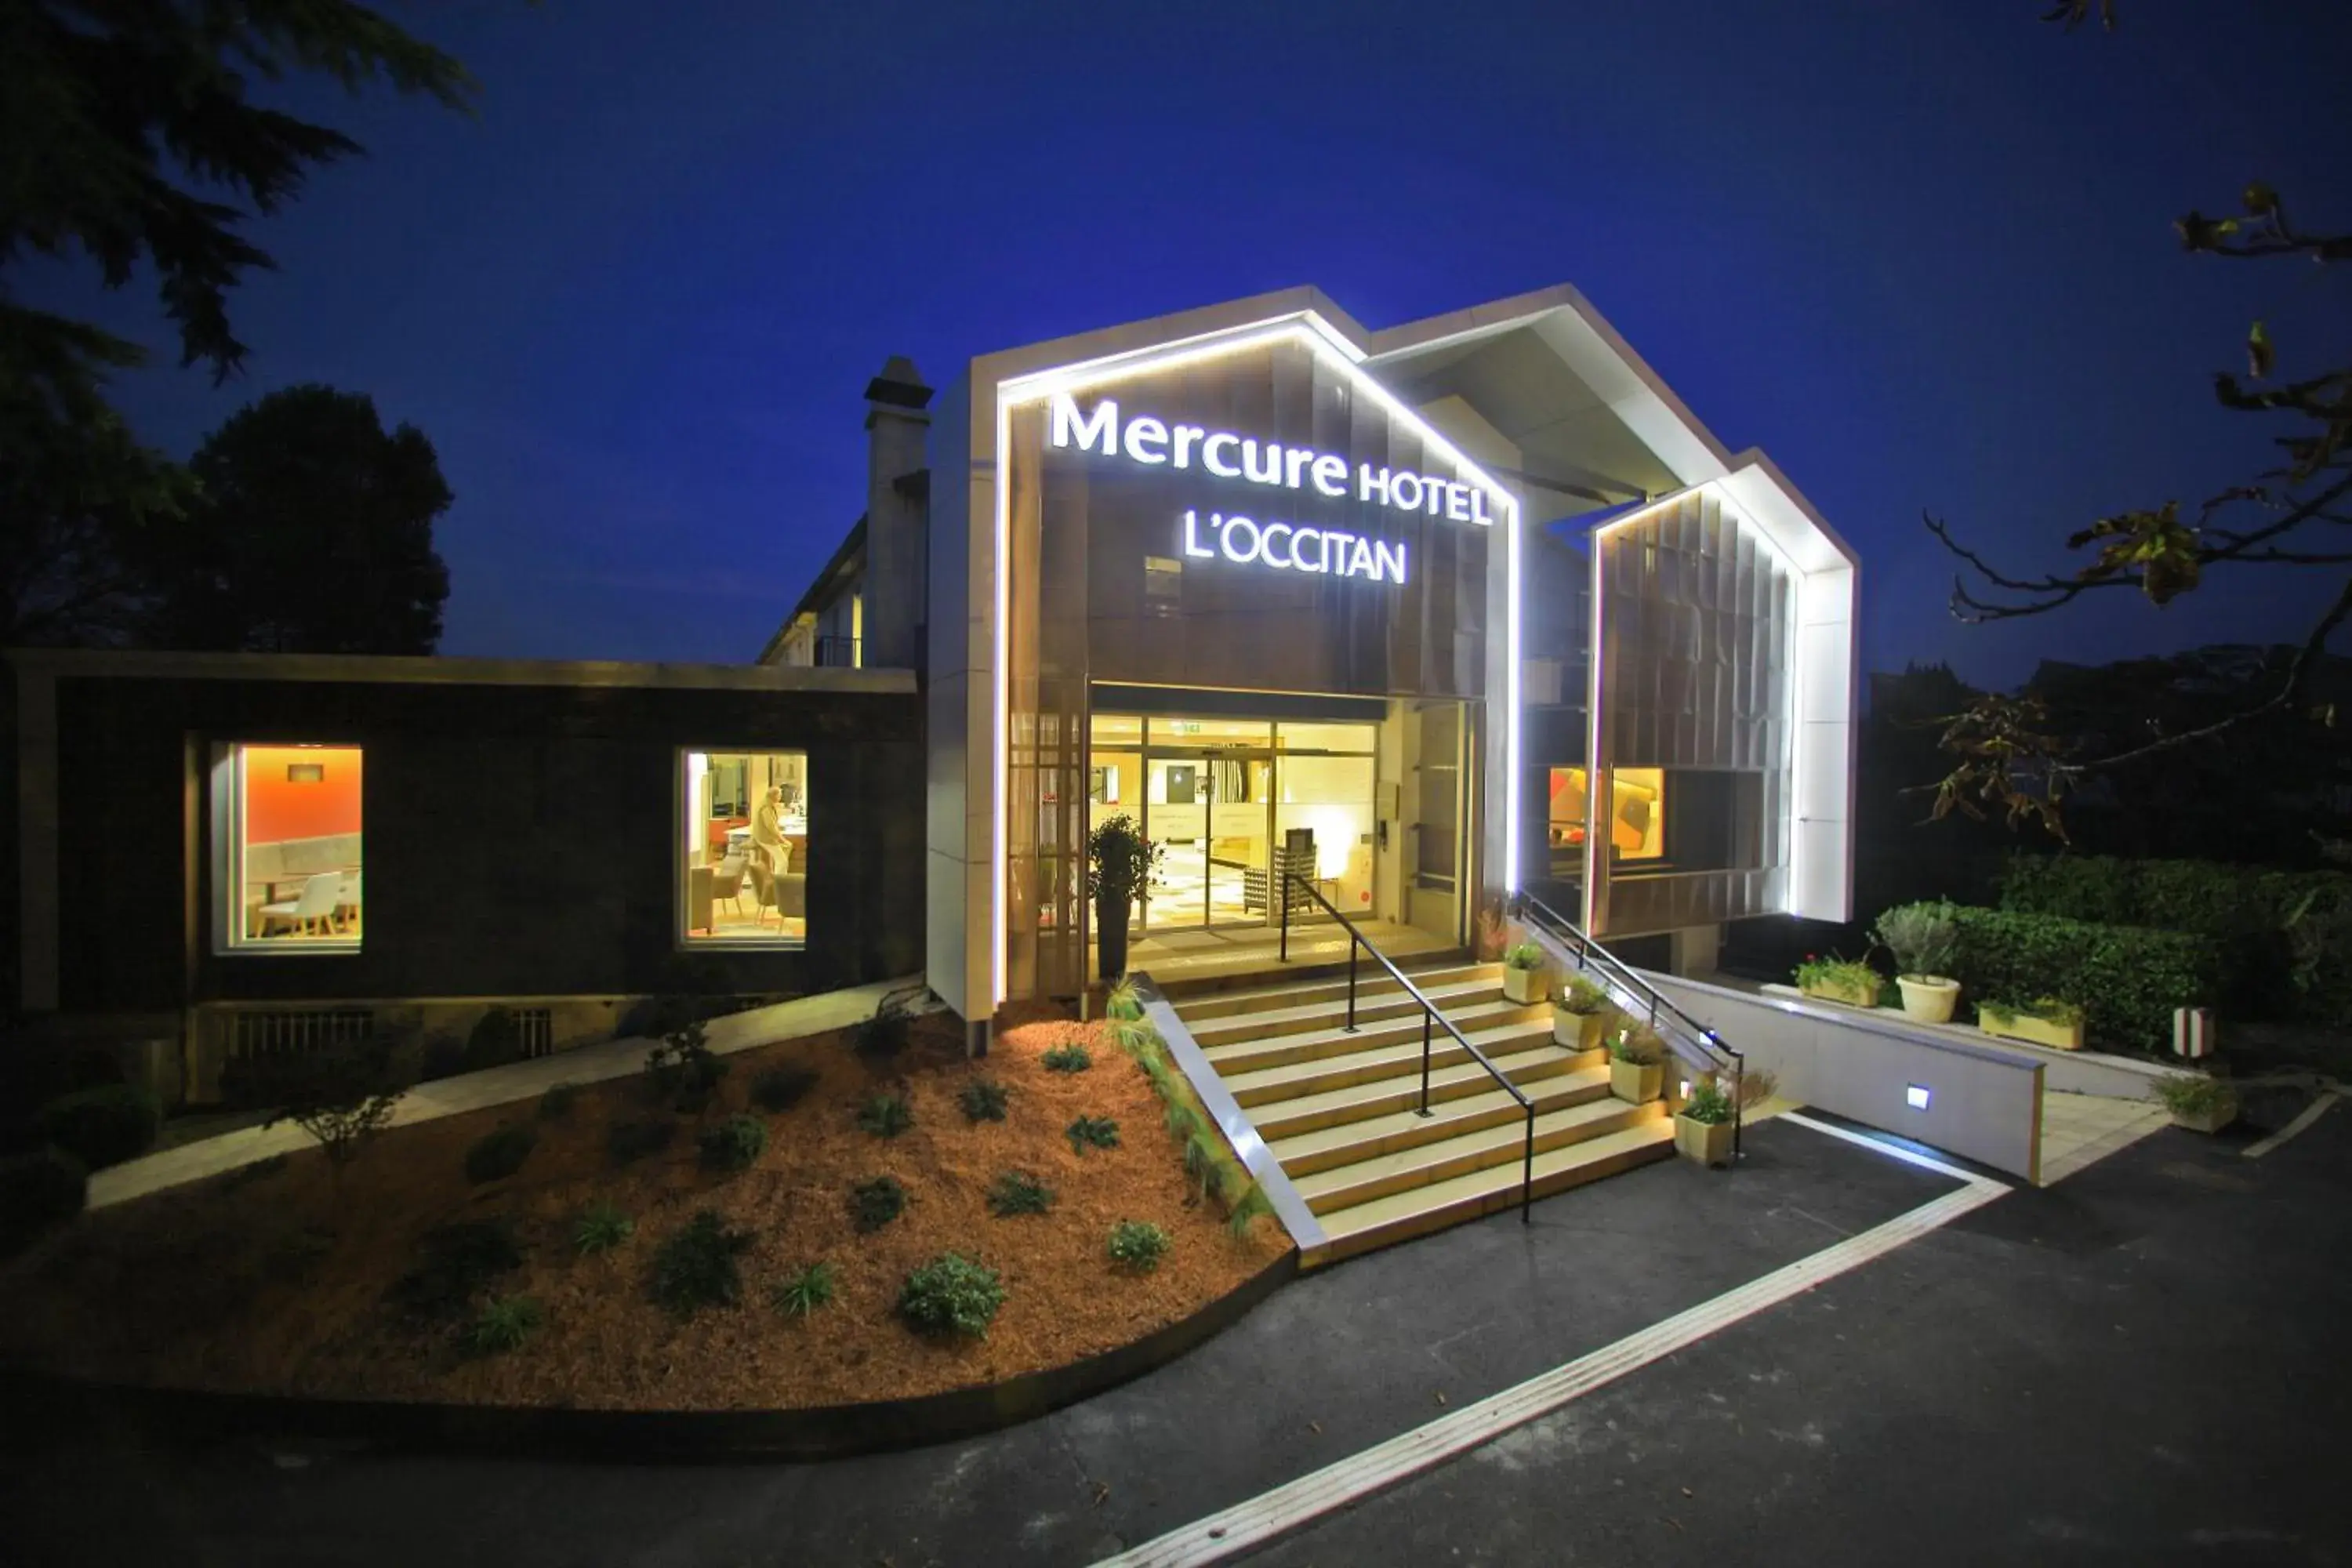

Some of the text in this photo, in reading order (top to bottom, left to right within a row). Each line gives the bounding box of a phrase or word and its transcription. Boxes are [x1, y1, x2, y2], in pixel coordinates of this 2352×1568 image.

[1051, 390, 1494, 526] Mercure HOTEL
[1184, 510, 1406, 585] L'OCCITAN
